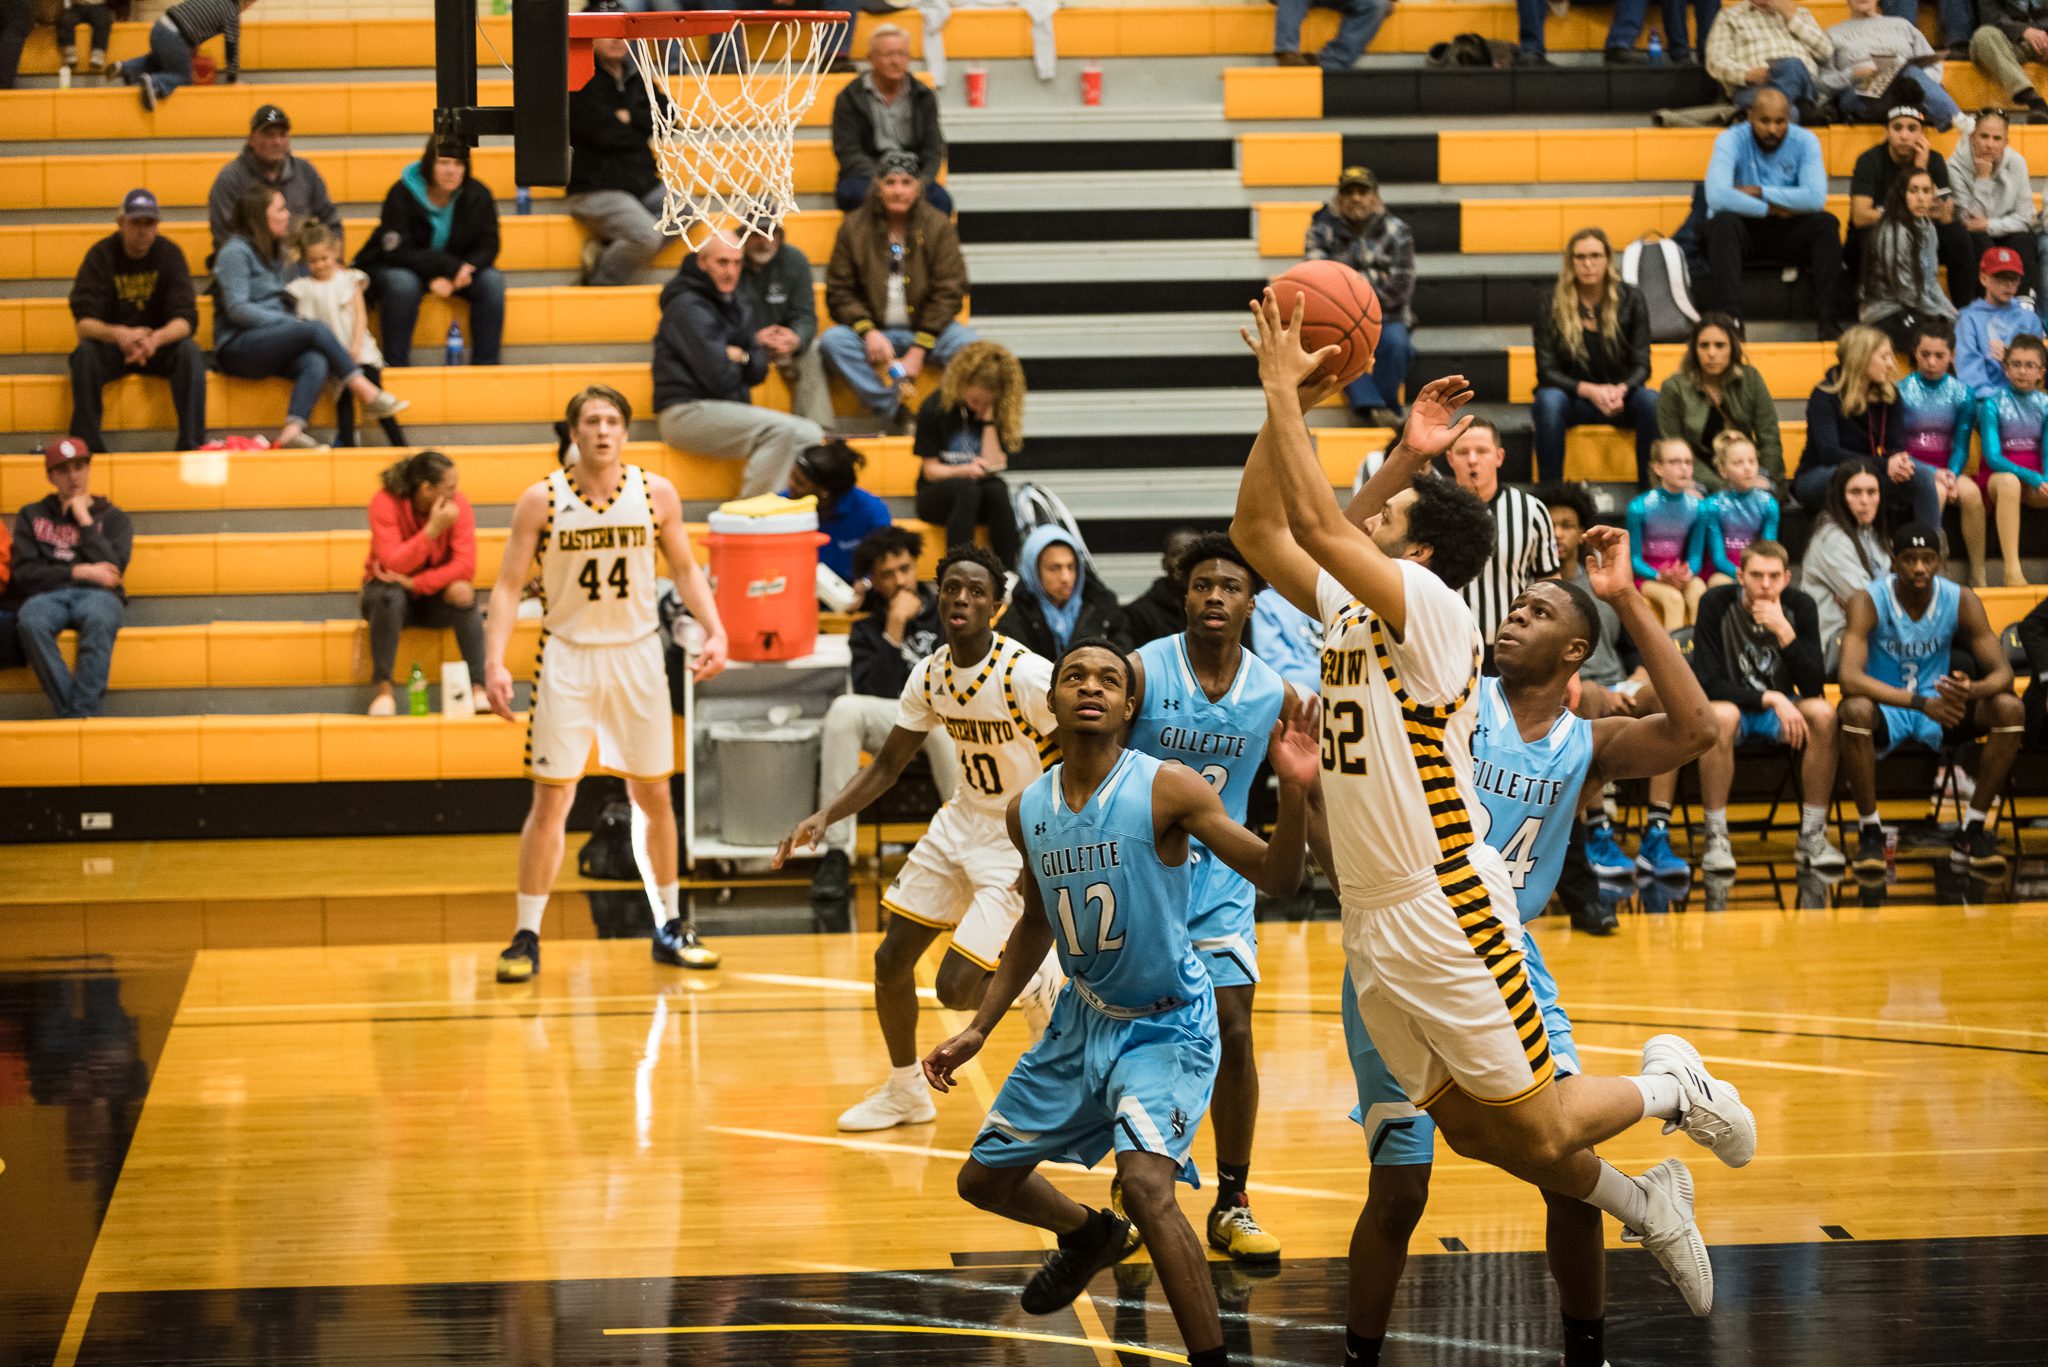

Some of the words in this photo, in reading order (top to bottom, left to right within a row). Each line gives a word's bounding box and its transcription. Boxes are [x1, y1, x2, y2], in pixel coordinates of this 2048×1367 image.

[577, 557, 629, 601] 44
[978, 719, 1014, 744] WYO
[1160, 726, 1247, 758] GILLETTE
[1321, 697, 1367, 775] 52
[961, 749, 1004, 795] 10
[1041, 841, 1121, 878] GILLETTE
[1480, 802, 1545, 889] 4
[1052, 882, 1127, 957] 12
